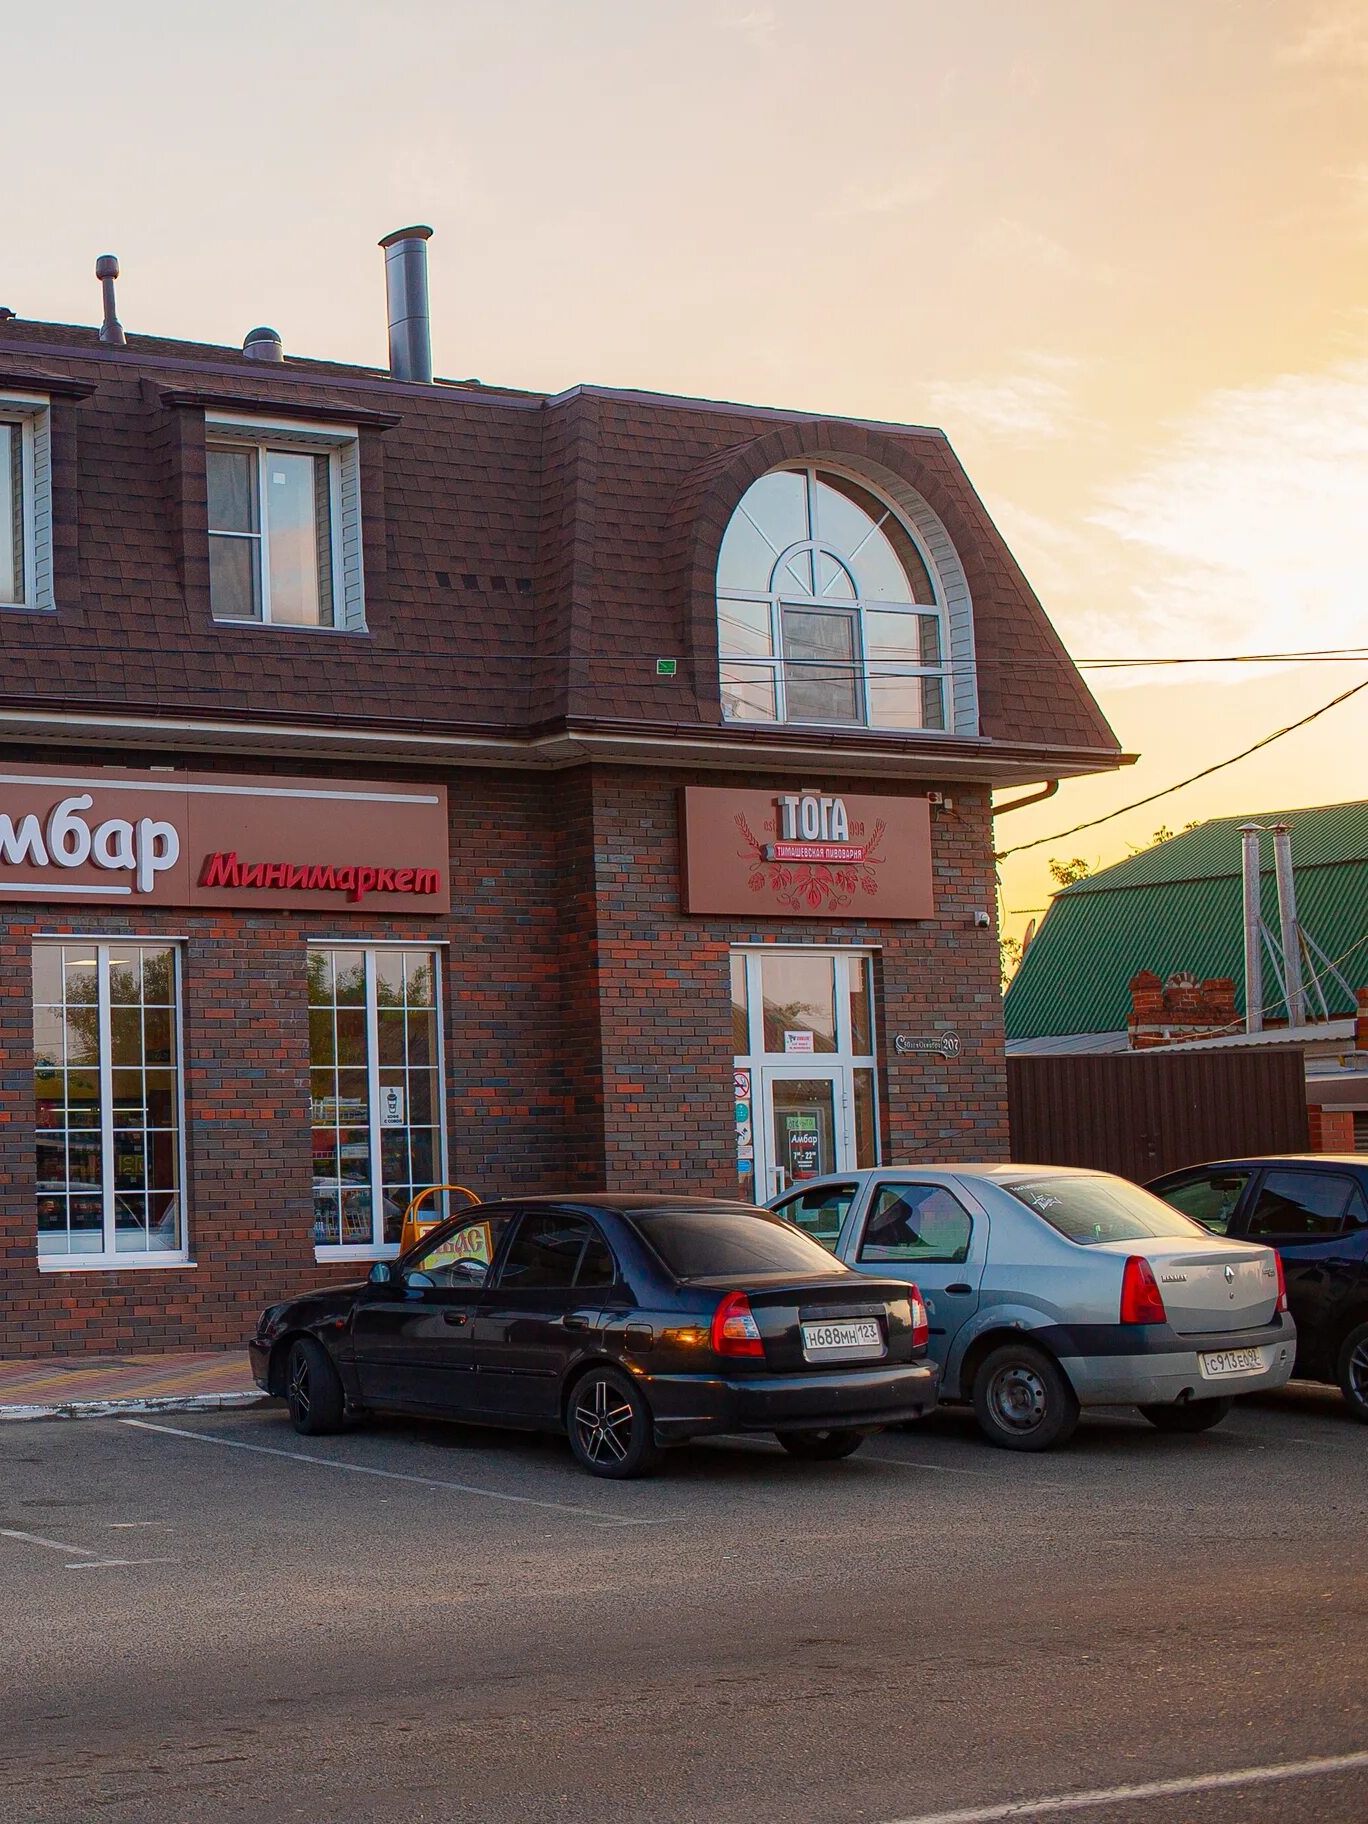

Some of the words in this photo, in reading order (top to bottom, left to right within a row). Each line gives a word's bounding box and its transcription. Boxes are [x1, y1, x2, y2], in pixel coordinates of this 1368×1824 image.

[778, 795, 850, 841] ТОГА
[777, 846, 825, 858] ТИМАШЕВСКАЯ
[825, 848, 862, 859] ПИВОВАРНЯ
[198, 851, 441, 902] Минимаркет
[942, 1038, 959, 1050] 207
[791, 1133, 818, 1146] Амбар
